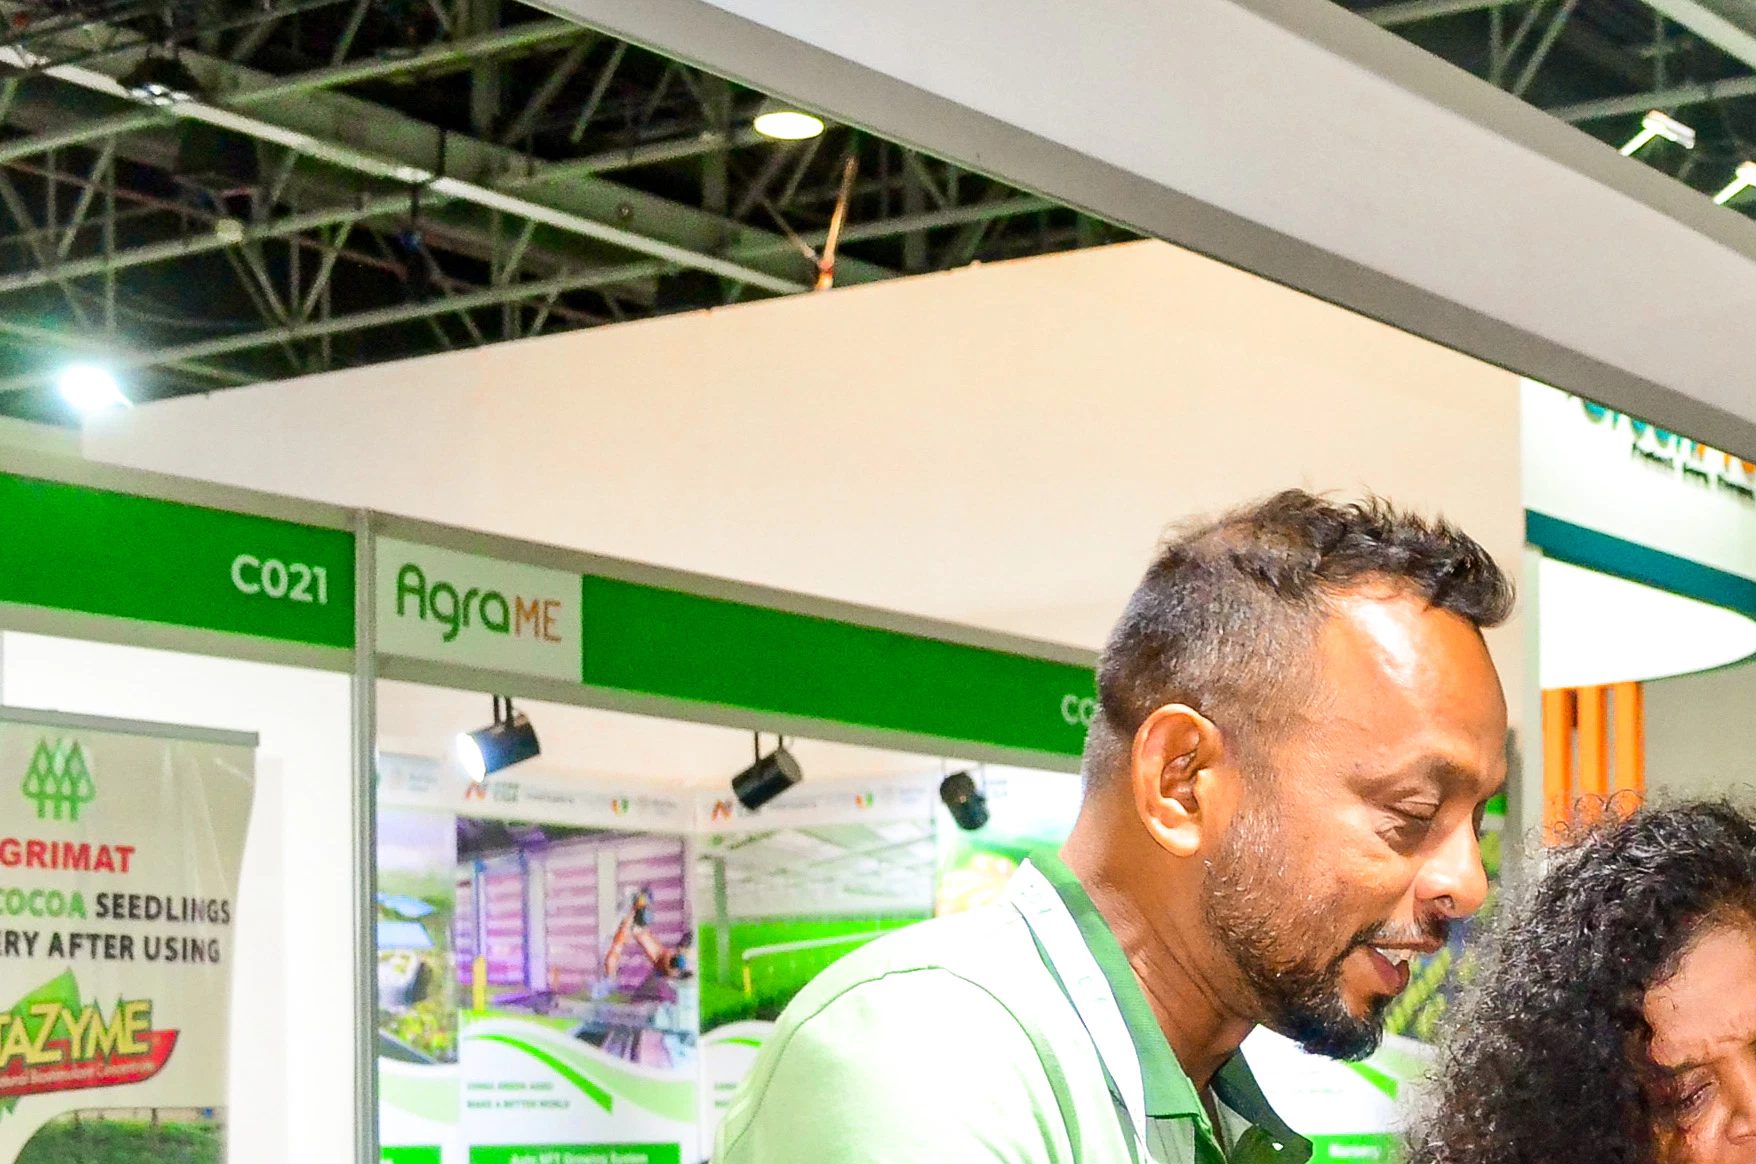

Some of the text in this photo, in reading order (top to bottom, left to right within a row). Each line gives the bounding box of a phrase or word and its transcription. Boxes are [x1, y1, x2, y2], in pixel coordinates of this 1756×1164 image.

[230, 554, 329, 604] C021
[395, 562, 563, 643] AgraME
[96, 892, 231, 924] SEEDLINGS
[0, 930, 221, 963] RY AFTER USING
